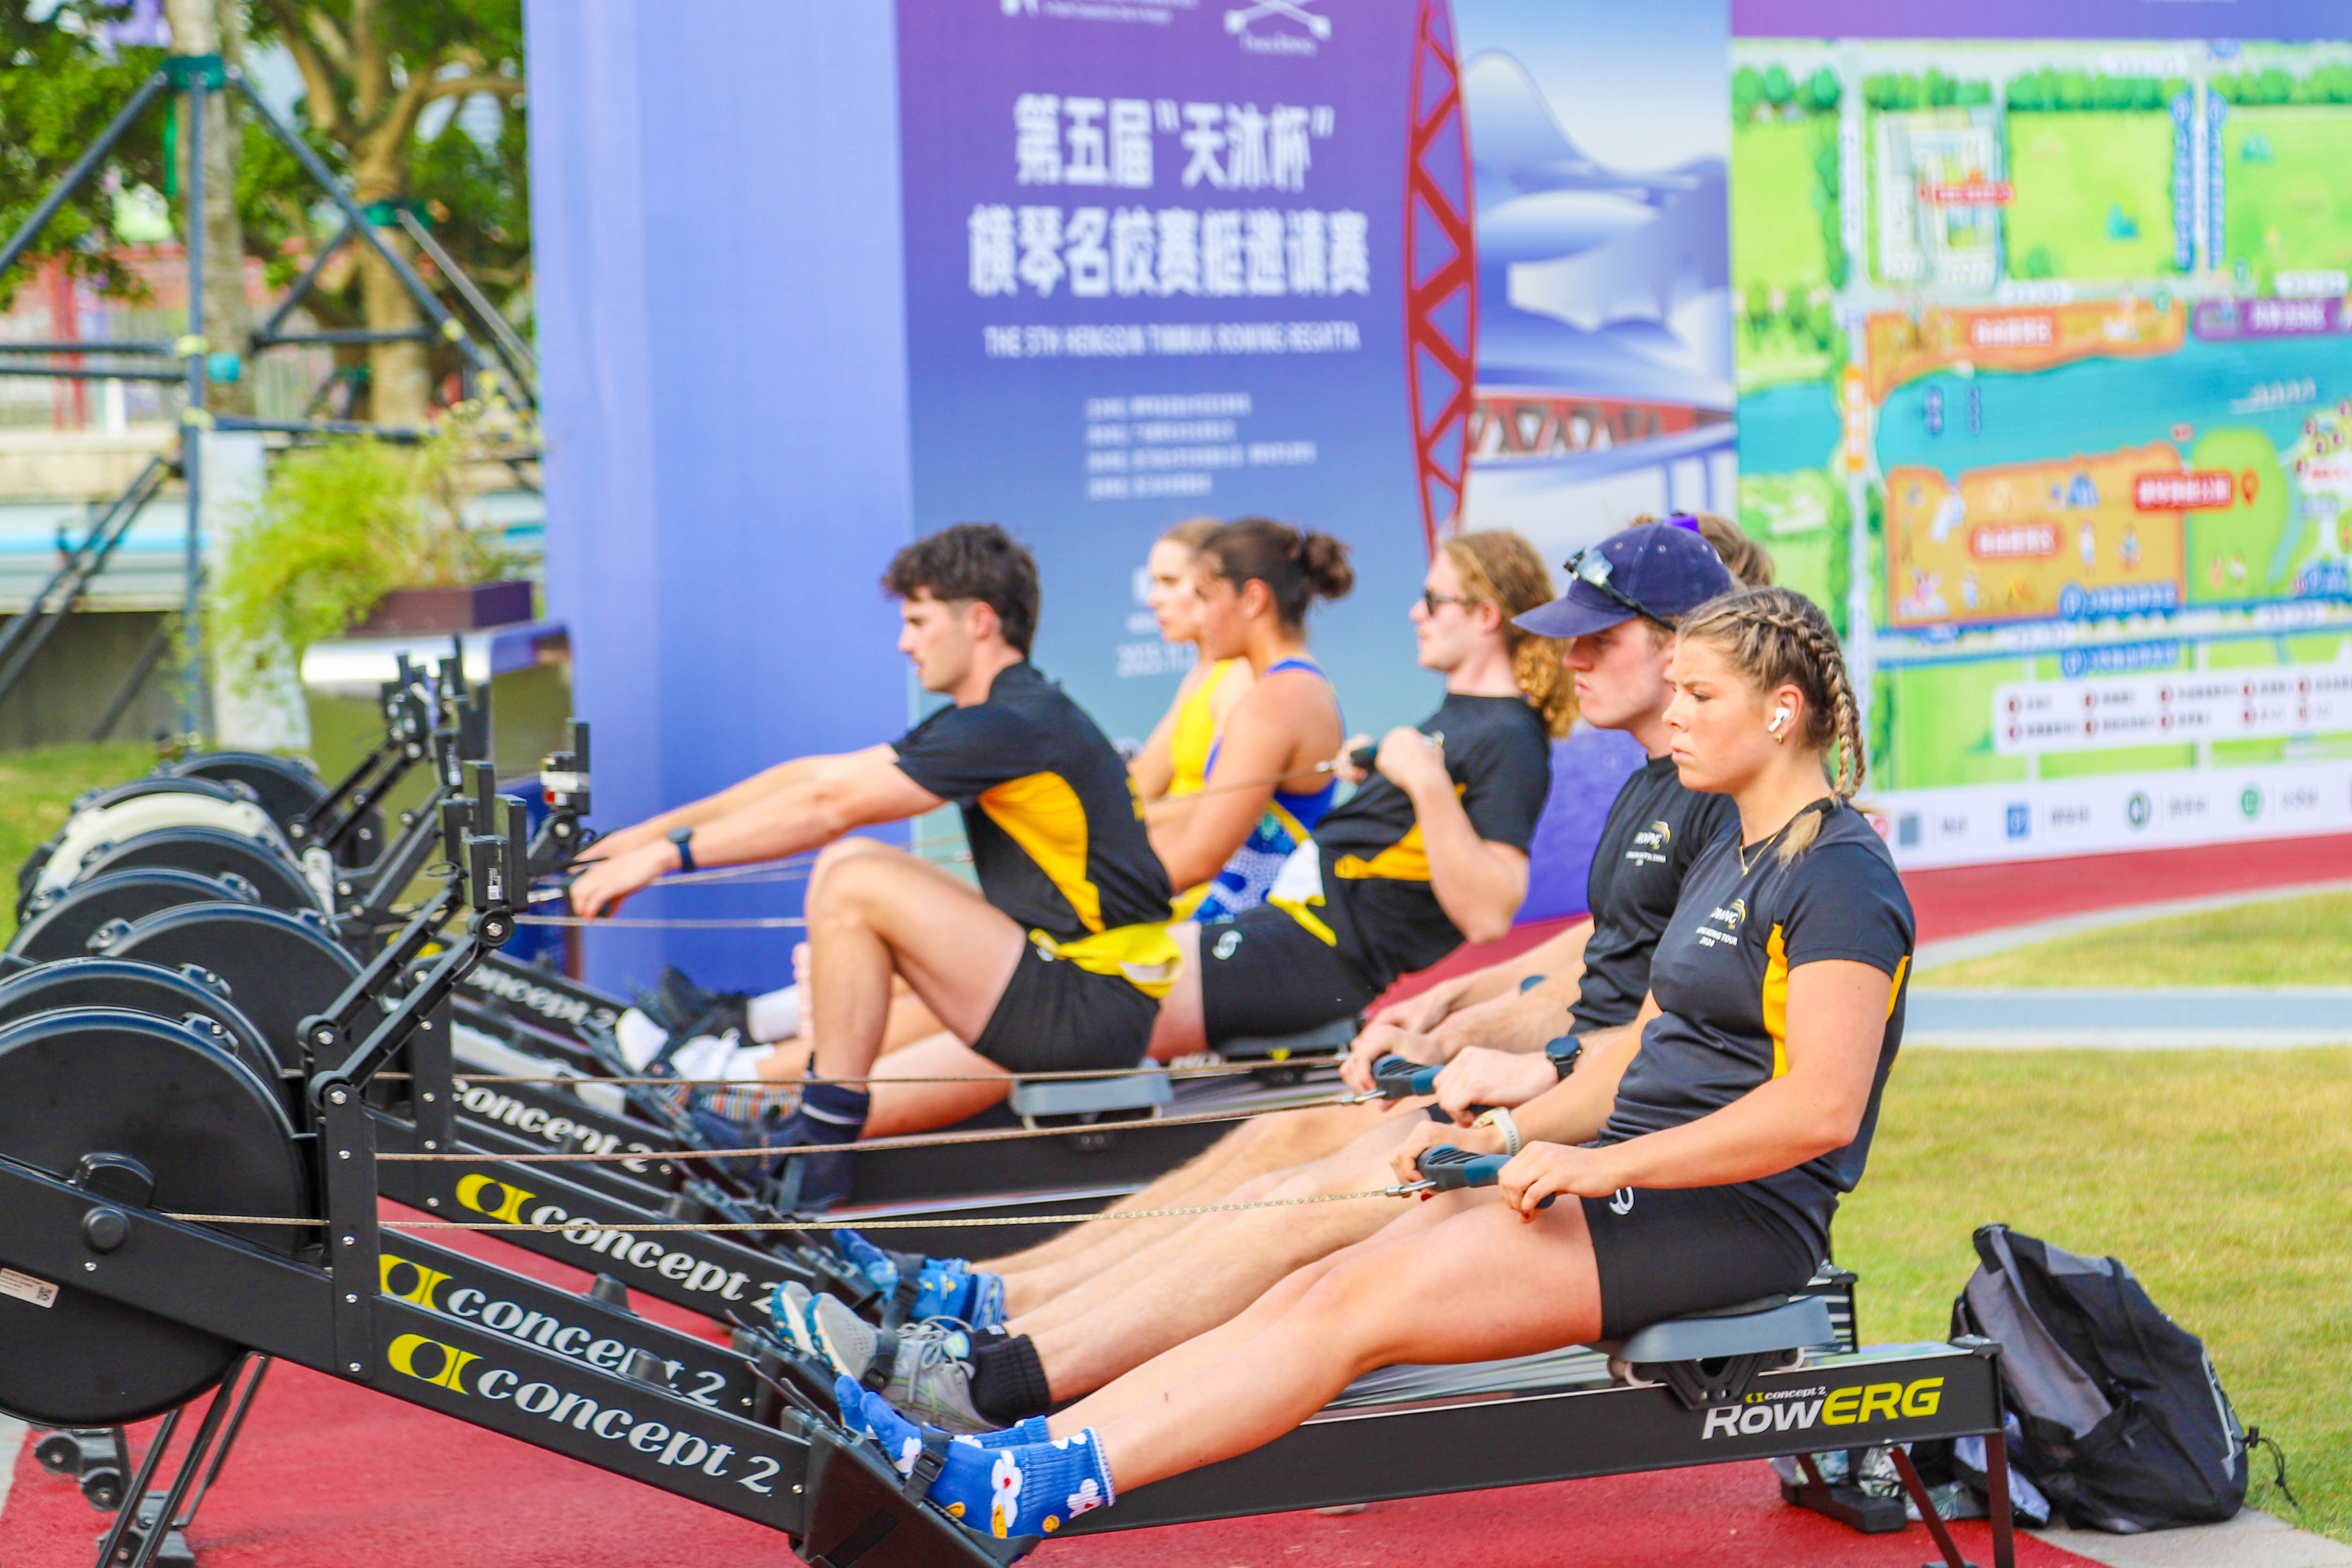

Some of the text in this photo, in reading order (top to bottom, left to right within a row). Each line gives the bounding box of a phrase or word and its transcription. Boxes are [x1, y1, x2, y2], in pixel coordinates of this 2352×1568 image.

[967, 204, 1370, 297] 横琴名校赛艇邀请赛
[620, 1142, 655, 1174] 2
[531, 1204, 751, 1301] concept
[686, 1370, 727, 1407] 2
[1764, 1387, 1815, 1401] concept
[477, 1368, 780, 1494] concept 2
